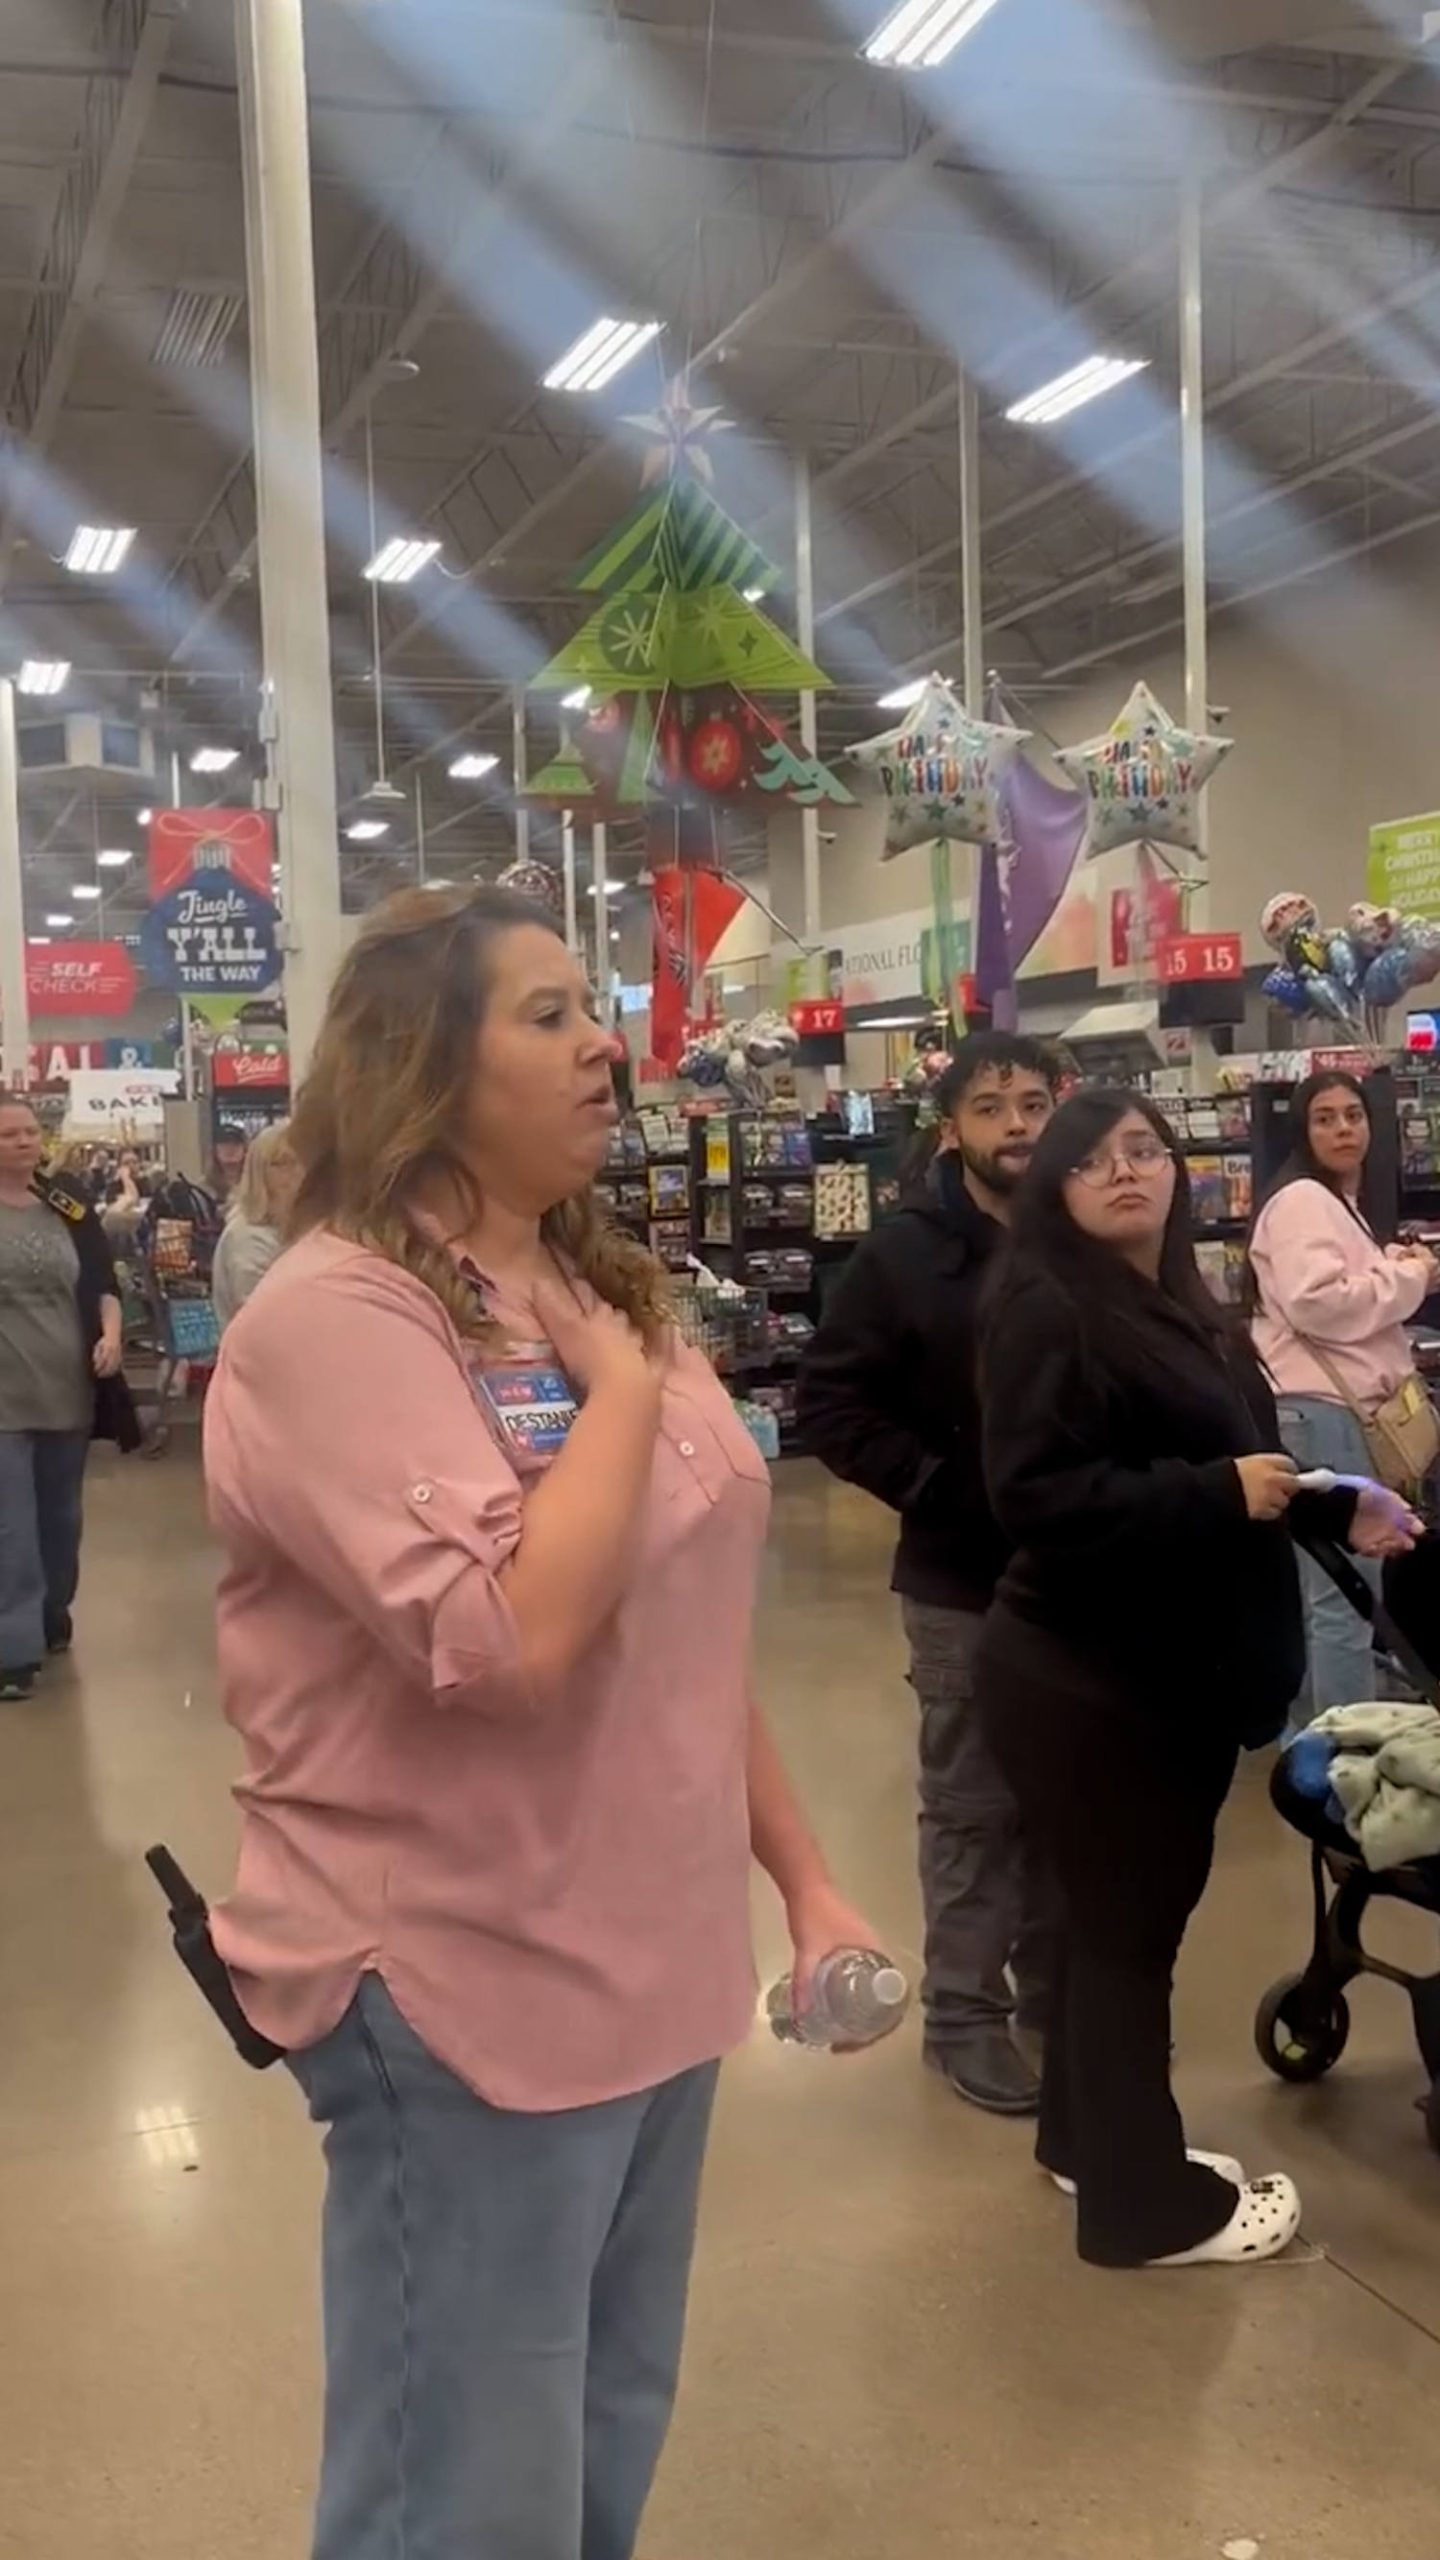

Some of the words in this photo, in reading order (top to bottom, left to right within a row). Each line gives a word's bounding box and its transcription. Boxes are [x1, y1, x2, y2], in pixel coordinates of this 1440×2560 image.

[177, 889, 248, 923] Jingle
[166, 926, 267, 963] Y'ALL
[51, 962, 103, 977] SELF
[1166, 948, 1187, 976] 15
[1202, 946, 1234, 973] 15
[180, 965, 215, 982] THE
[220, 964, 262, 981] WAY
[29, 977, 97, 995] CHECK
[813, 1009, 836, 1027] 17
[232, 1054, 282, 1078] Cold
